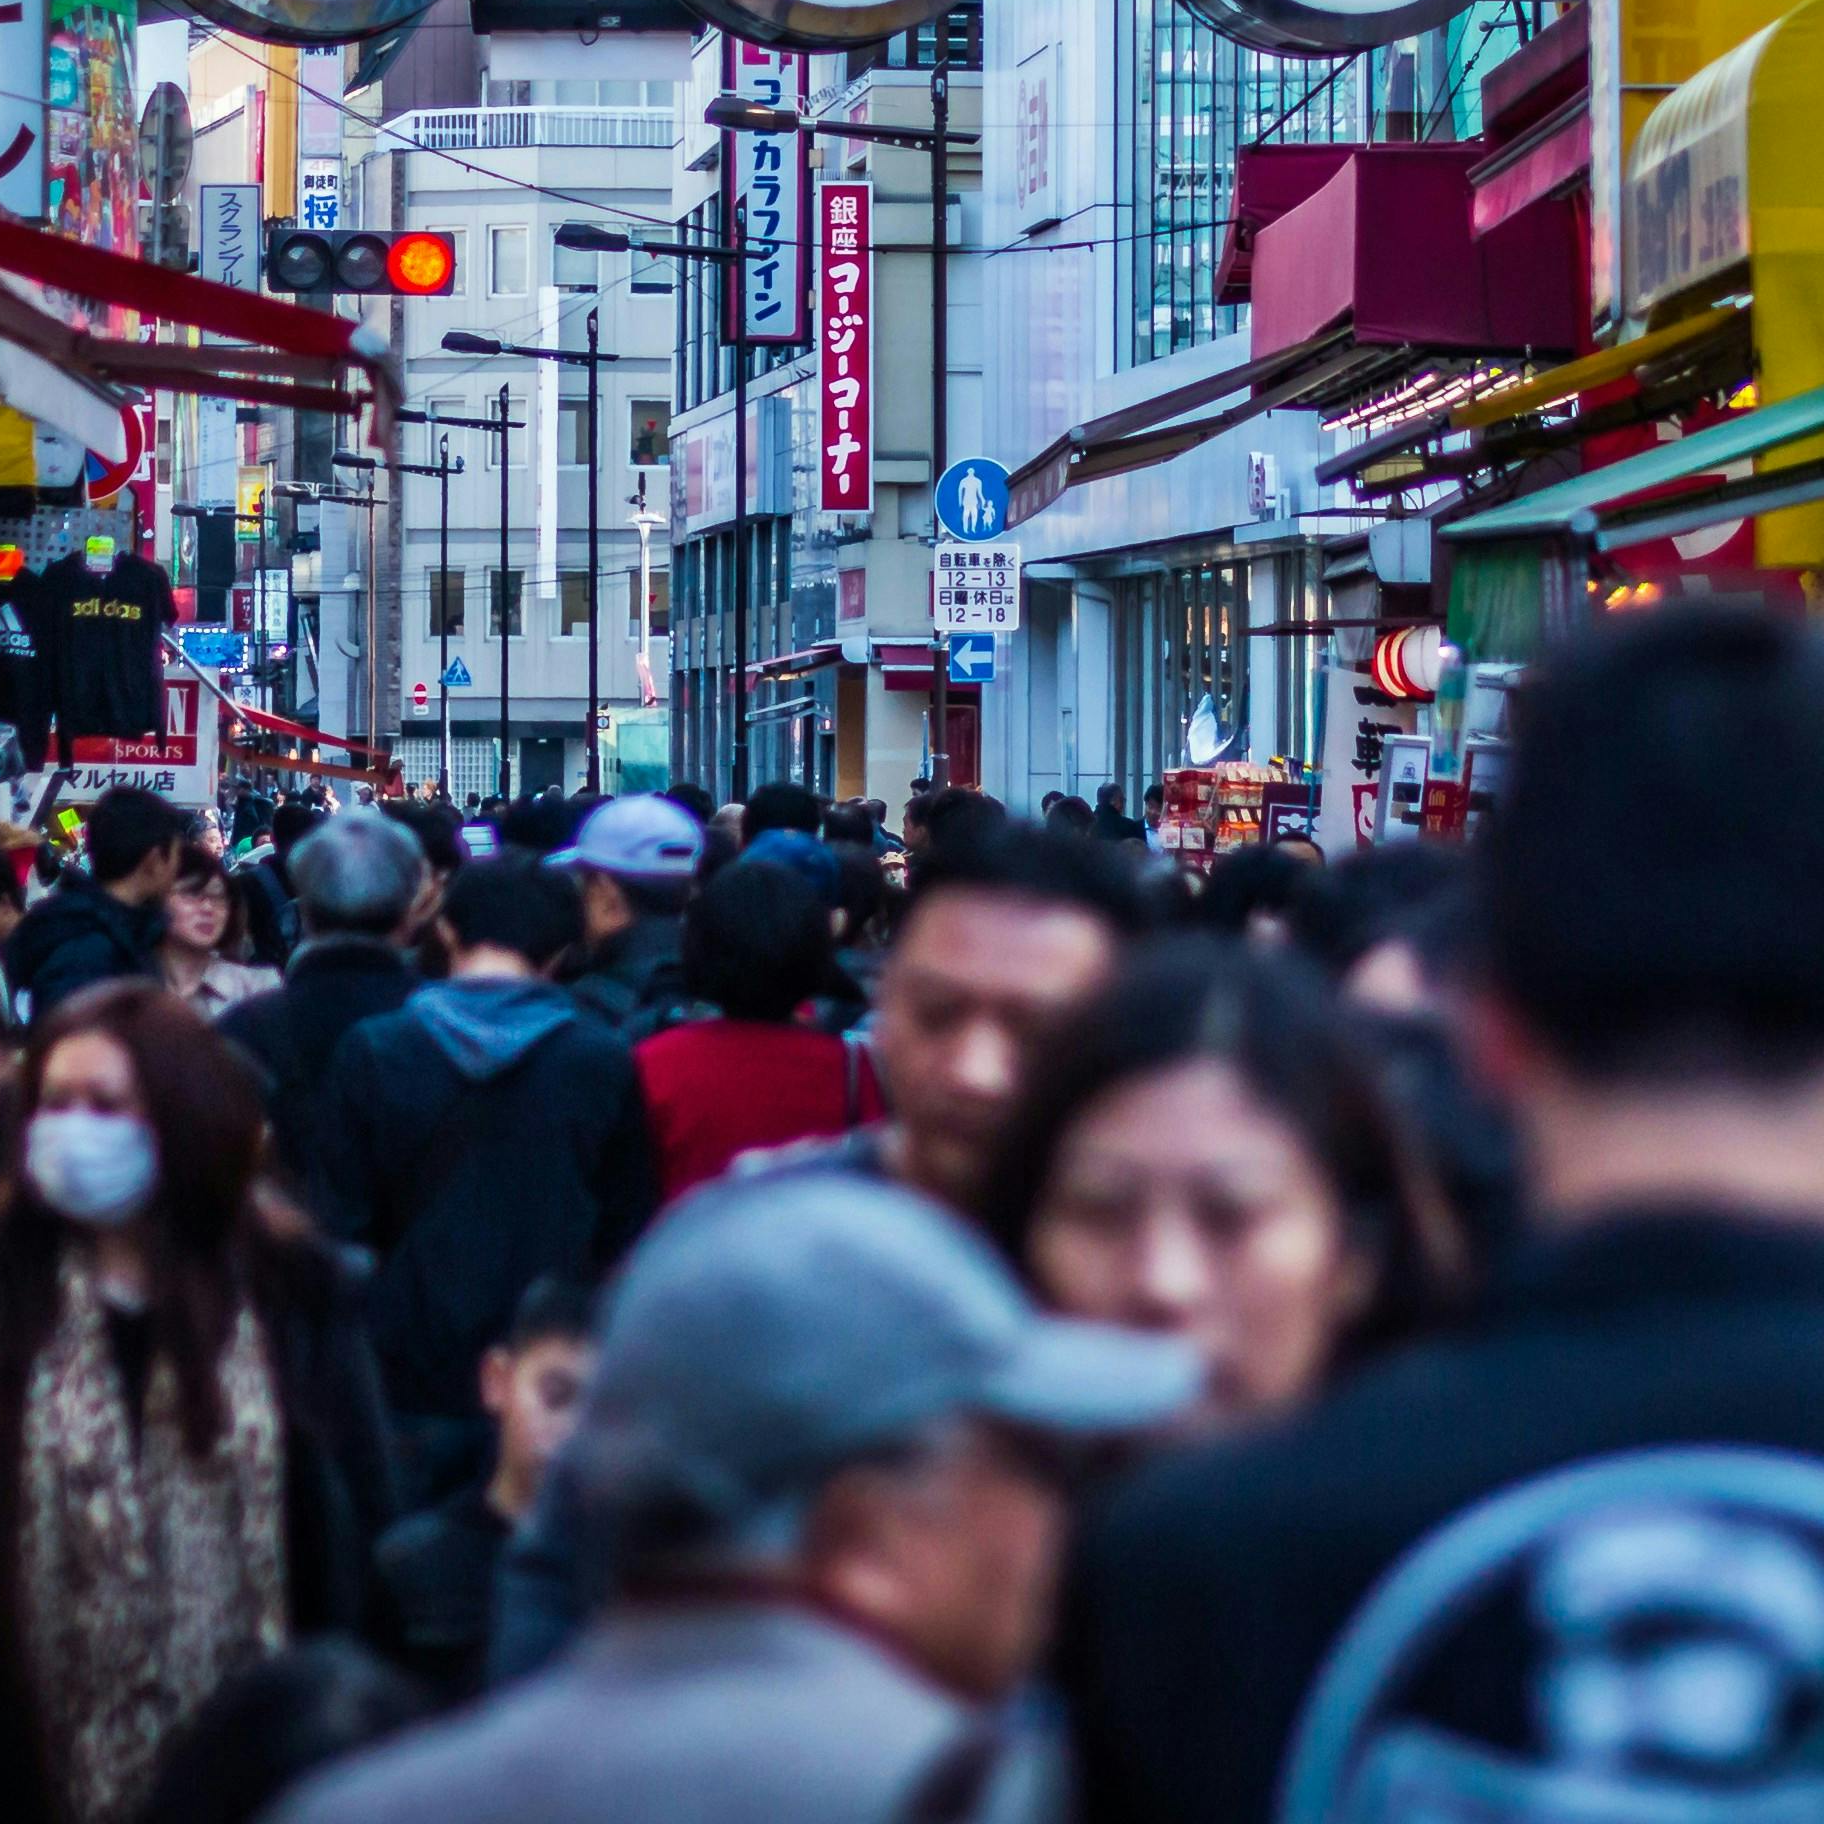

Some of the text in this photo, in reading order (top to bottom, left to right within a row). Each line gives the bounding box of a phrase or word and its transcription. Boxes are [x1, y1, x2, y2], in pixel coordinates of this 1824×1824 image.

[303, 174, 338, 190] 御徒町
[826, 195, 864, 495] 銀座コージーコーナー
[939, 552, 1015, 567] 自転車を除く
[64, 768, 176, 792] マルセル店
